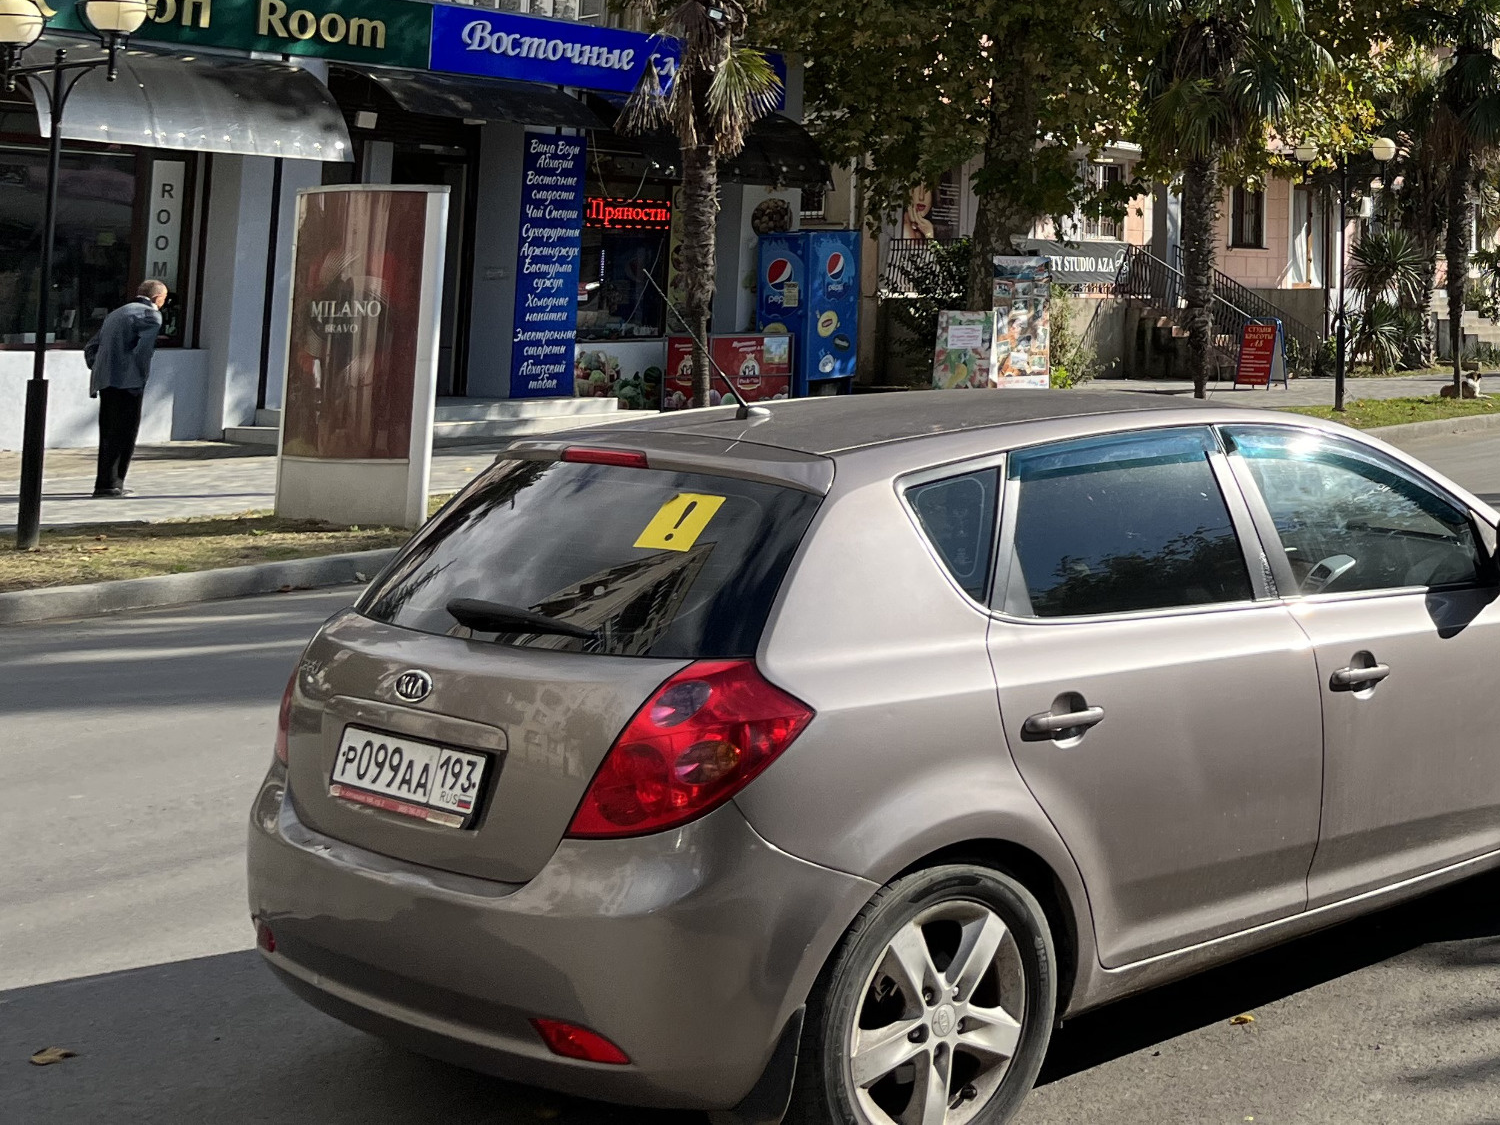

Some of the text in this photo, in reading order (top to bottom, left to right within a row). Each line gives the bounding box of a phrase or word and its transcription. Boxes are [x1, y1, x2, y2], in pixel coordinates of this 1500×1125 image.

[461, 20, 636, 71] Восточные
[530, 139, 581, 160] Вина Воды
[536, 153, 574, 174] Абхазии
[526, 170, 578, 186] Восточные
[531, 189, 575, 205] сладости
[526, 204, 578, 222] Чай Специи
[590, 199, 667, 225] Пряности
[152, 183, 175, 277] ROOM
[523, 259, 573, 278] Бастурма
[1064, 256, 1096, 272] STUDIO
[1097, 257, 1115, 272] AZA
[827, 283, 844, 292] pepsi
[525, 293, 570, 312] Холодные
[768, 295, 784, 304] pep
[311, 300, 382, 320] MILANO
[525, 311, 568, 322] напитки
[324, 323, 359, 334] BRAVO
[513, 328, 577, 345] Электронные
[518, 359, 567, 379] Абхазский
[528, 374, 558, 390] табак
[401, 675, 424, 698] KIA
[439, 755, 478, 794] 193
[439, 790, 459, 806] RUS
